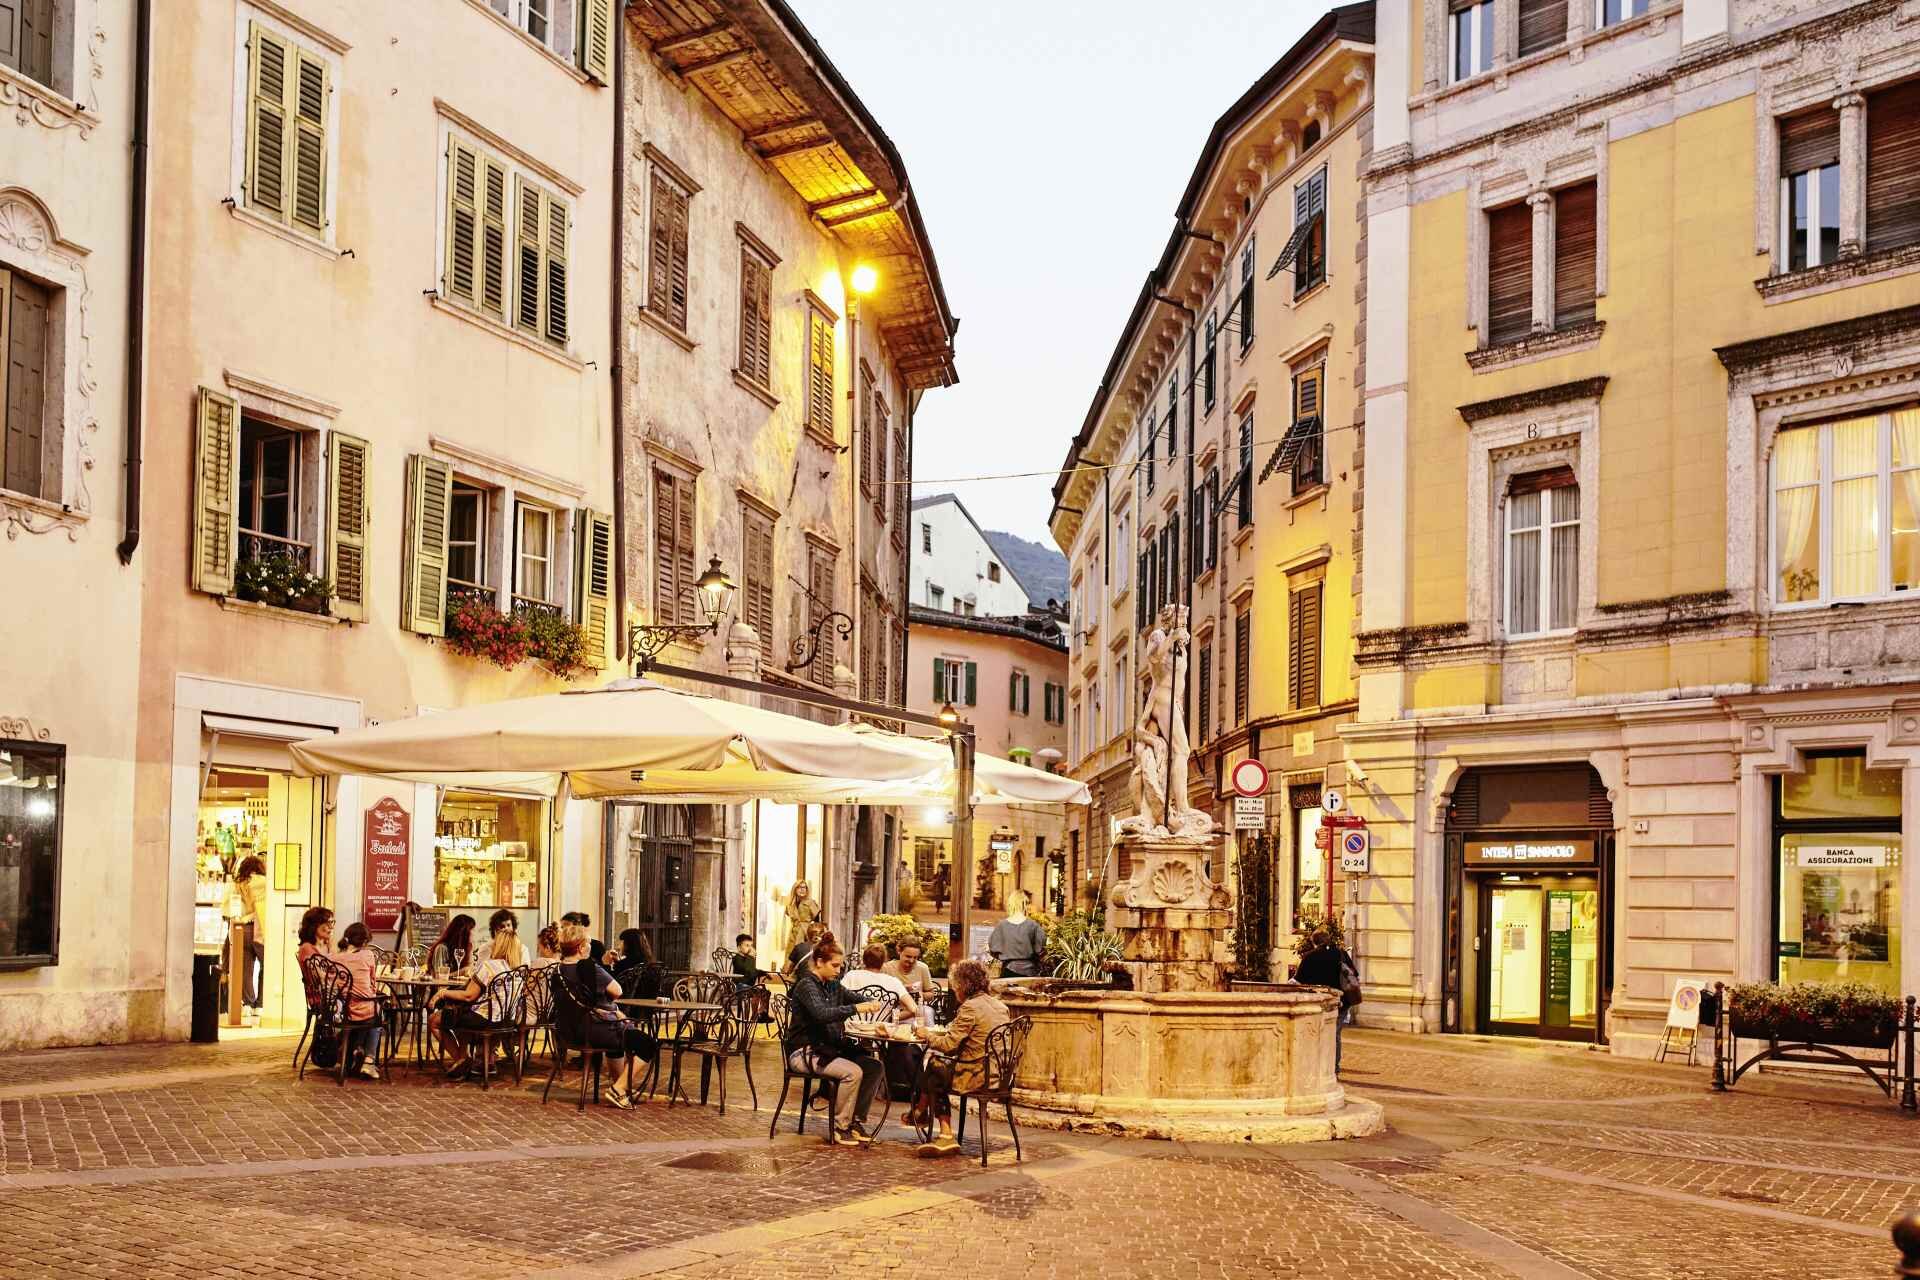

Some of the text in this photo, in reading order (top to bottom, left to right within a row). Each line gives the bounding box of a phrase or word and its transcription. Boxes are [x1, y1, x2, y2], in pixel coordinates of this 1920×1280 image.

[1835, 358, 1849, 375] M
[1528, 423, 1537, 439] B
[1481, 847, 1513, 858] INTESA
